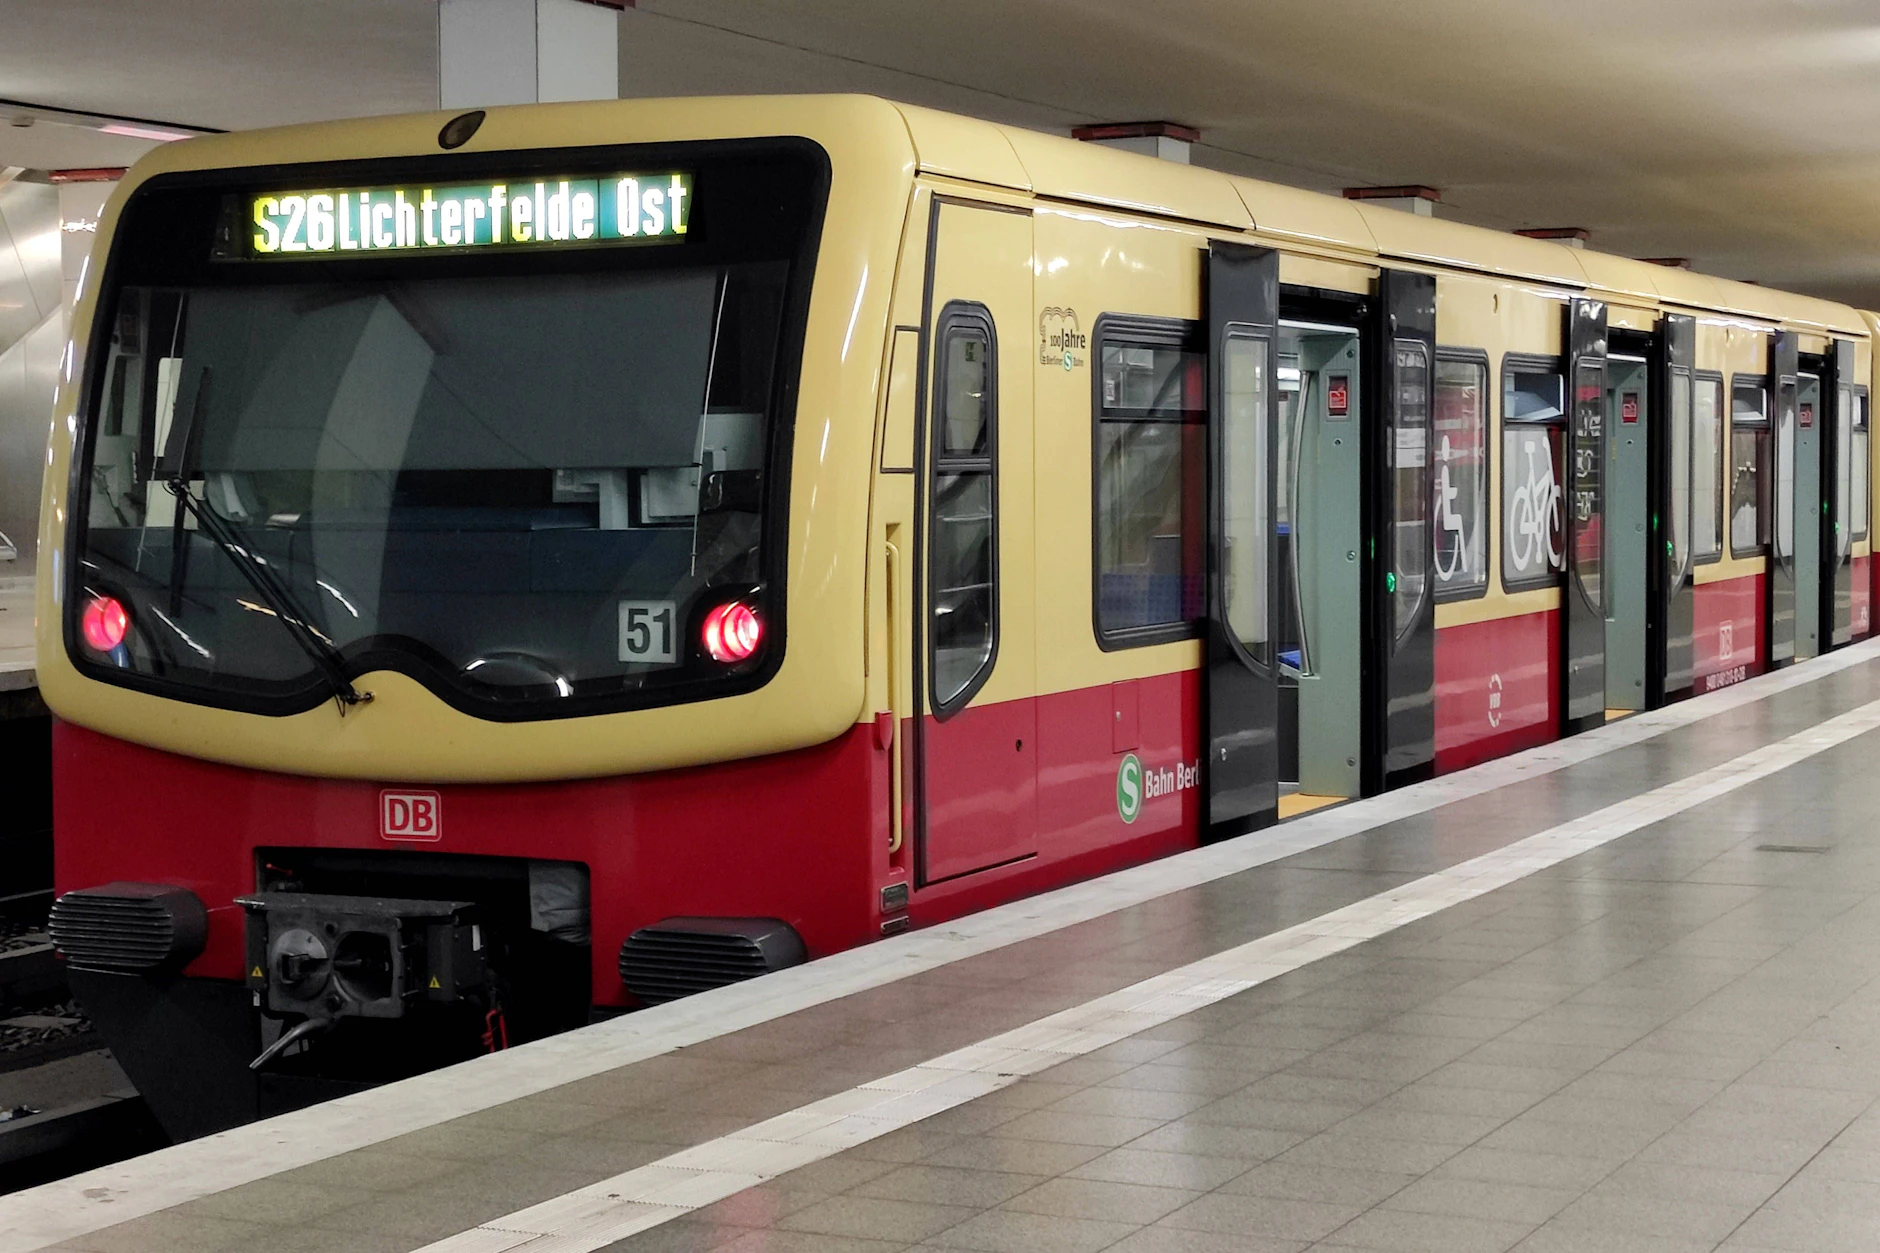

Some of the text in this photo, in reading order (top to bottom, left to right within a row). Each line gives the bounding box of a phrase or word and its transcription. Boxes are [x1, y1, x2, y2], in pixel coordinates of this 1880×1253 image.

[252, 174, 688, 253] S26 Lichterfelde Ost
[1050, 328, 1086, 352] 100 Jahre
[627, 608, 671, 654] 51
[1121, 762, 1139, 816] S
[1145, 766, 1174, 799] Bahn
[388, 798, 433, 832] DB
